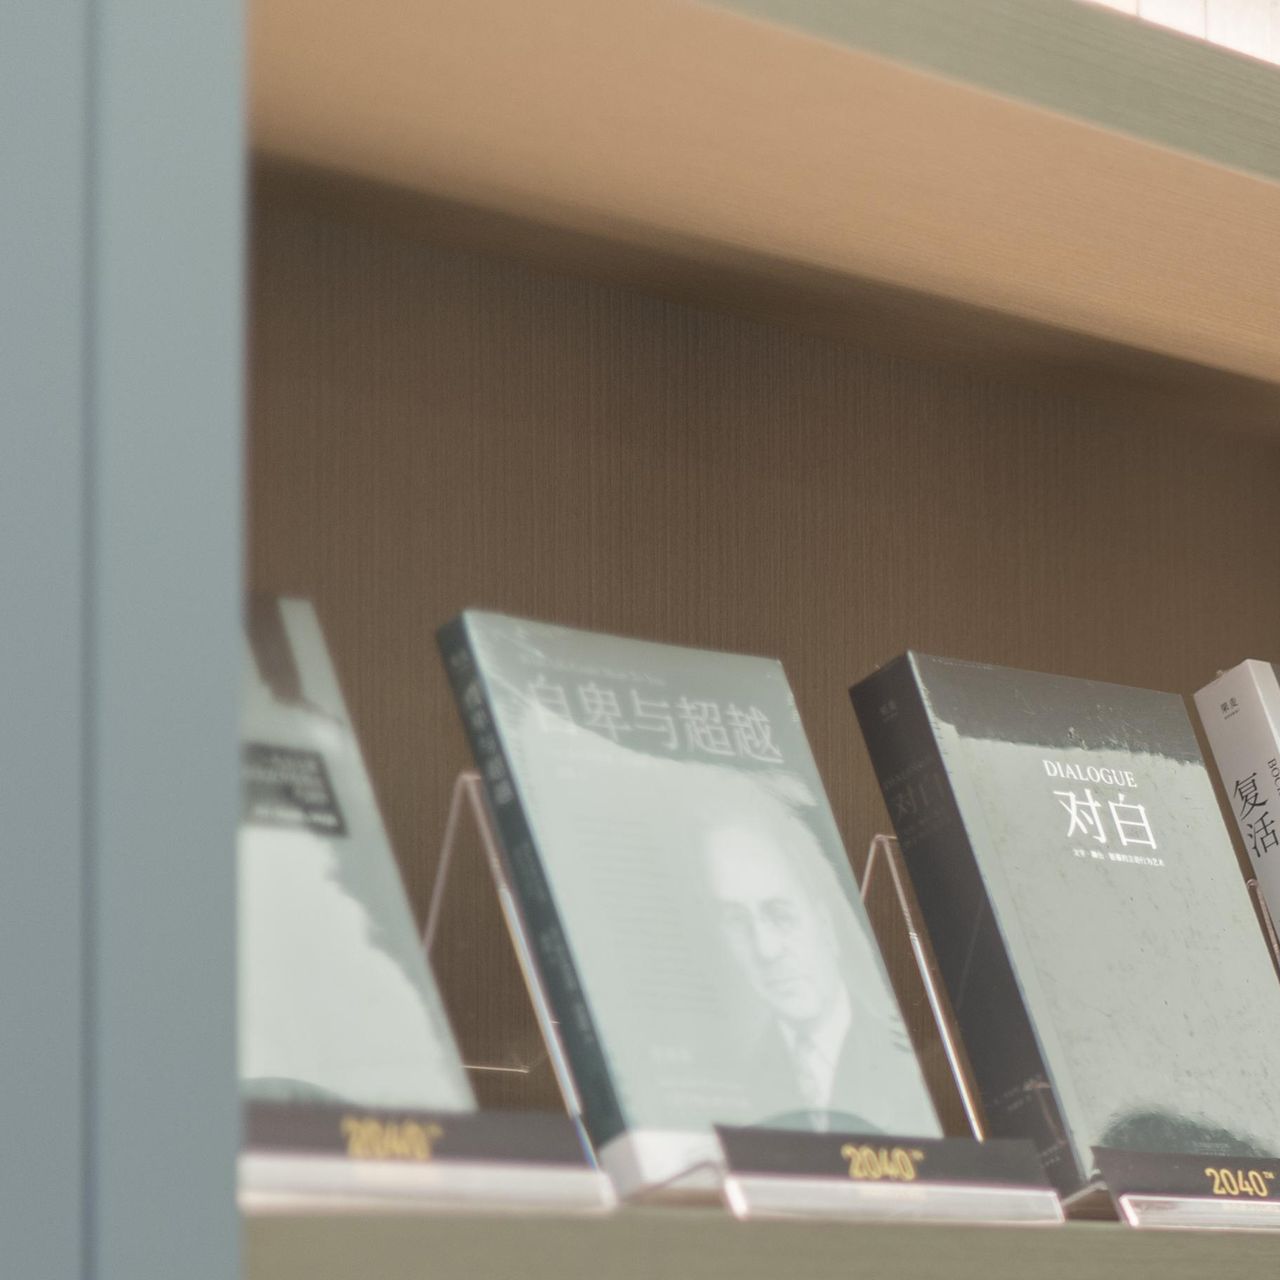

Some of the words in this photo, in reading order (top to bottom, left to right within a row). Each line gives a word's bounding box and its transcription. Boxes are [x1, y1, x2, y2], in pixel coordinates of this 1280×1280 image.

[528, 674, 784, 764] 自卑与超越
[1043, 759, 1138, 788] DIALOGUE
[1053, 788, 1157, 850] 对白
[1233, 772, 1279, 858] 复活
